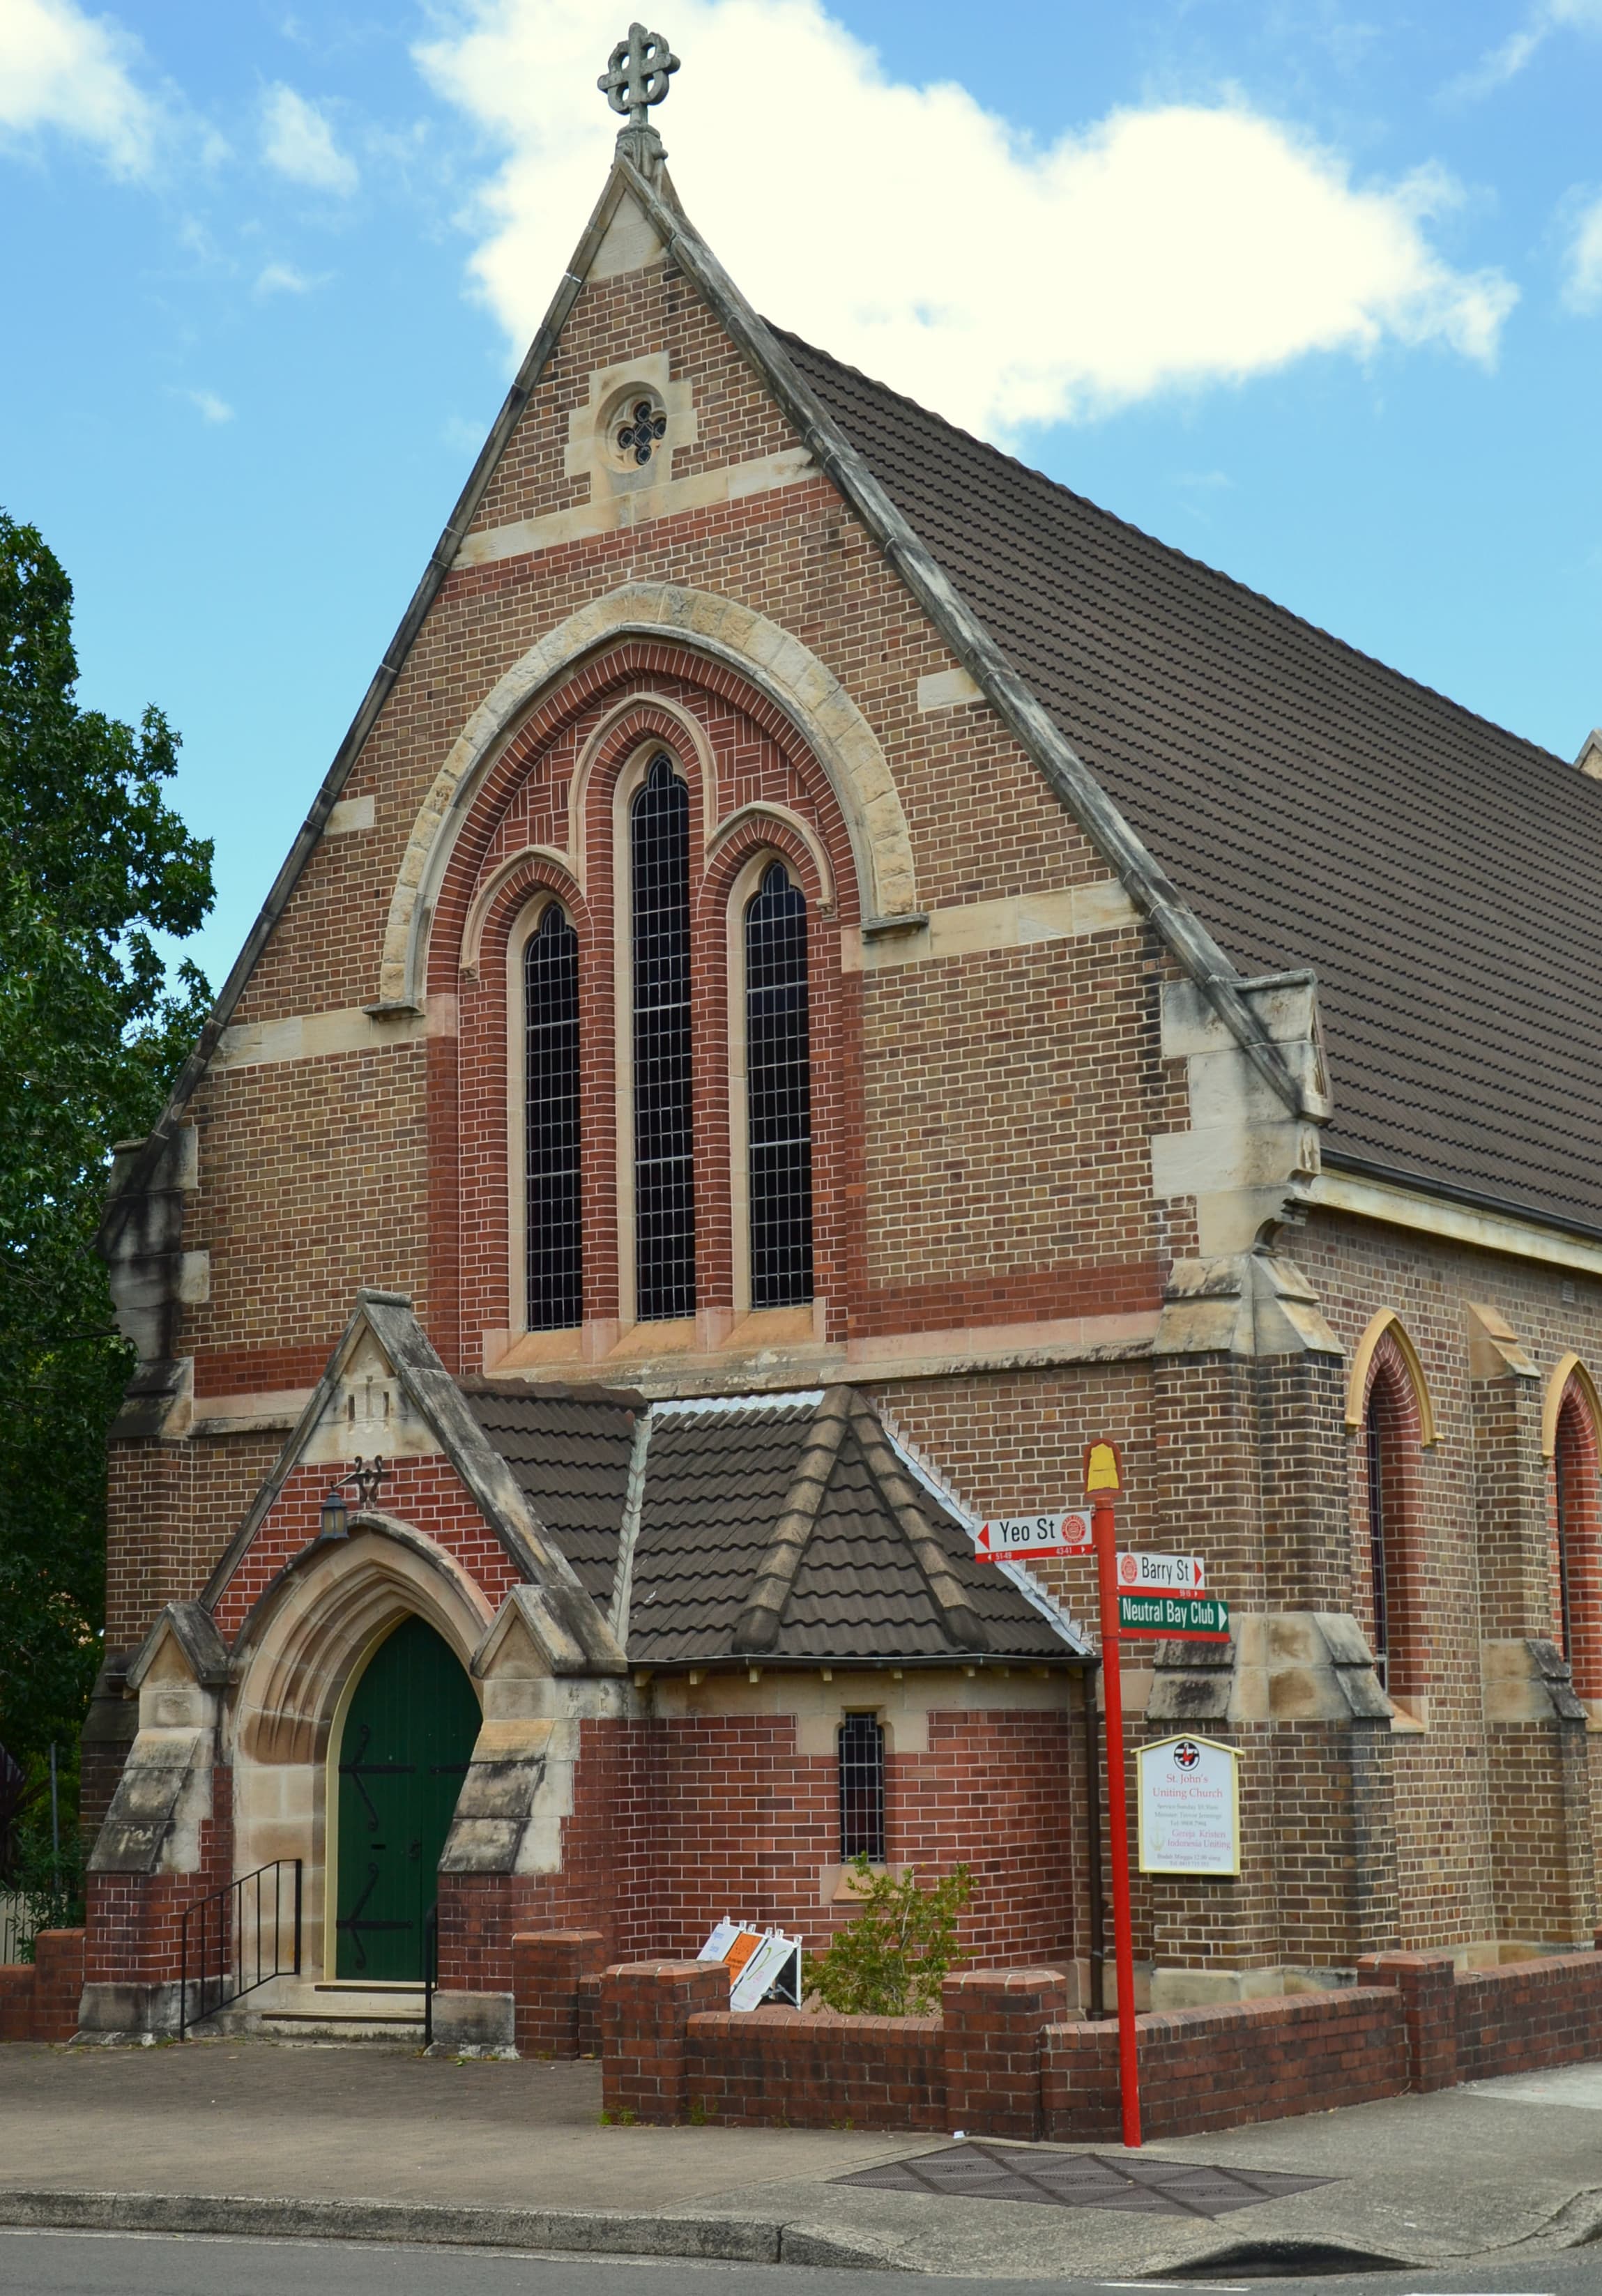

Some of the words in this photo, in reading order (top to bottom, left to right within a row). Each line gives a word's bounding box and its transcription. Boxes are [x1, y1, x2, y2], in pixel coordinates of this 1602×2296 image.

[1000, 1521, 1030, 1543] Yeo
[1037, 1518, 1055, 1540] St
[1142, 1556, 1172, 1585] Barry
[1177, 1559, 1189, 1582] St
[1122, 1597, 1163, 1622] Neutral
[1166, 1600, 1187, 1628] Bay
[1191, 1601, 1214, 1625] Club
[1166, 1774, 1177, 1783] St.
[1180, 1773, 1208, 1784] John's
[1152, 1788, 1187, 1800] Uniting
[1189, 1788, 1222, 1798] Church
[1199, 1829, 1226, 1838] Kristen
[1168, 1839, 1202, 1847] Indonesia
[1203, 1839, 1231, 1851] Uniting
